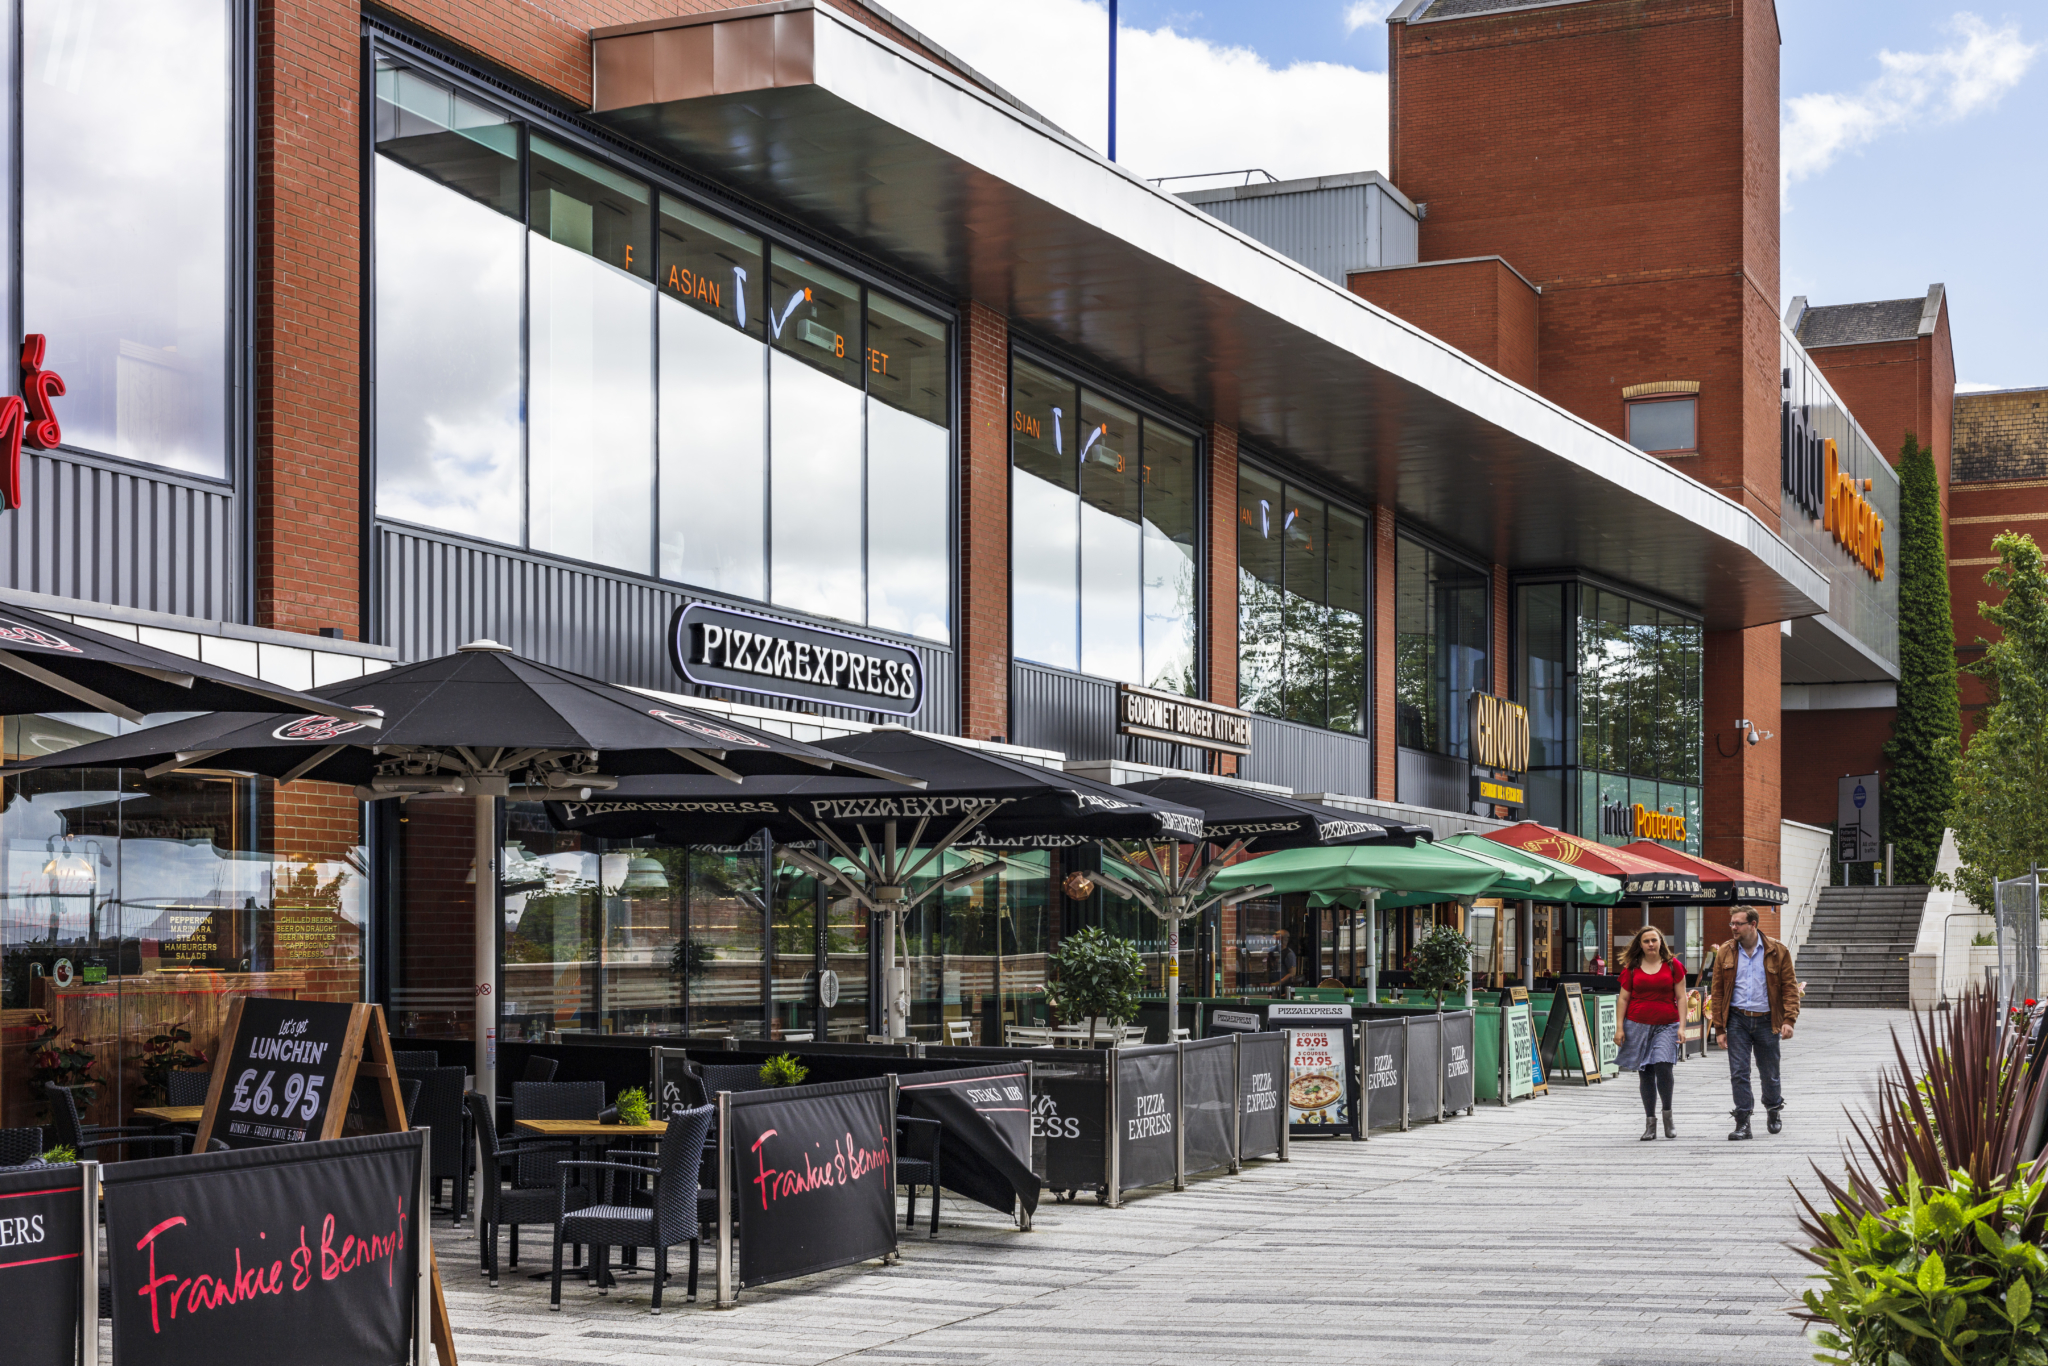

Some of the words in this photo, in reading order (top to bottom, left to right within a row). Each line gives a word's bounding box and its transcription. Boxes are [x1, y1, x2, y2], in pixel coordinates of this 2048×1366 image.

[669, 264, 720, 308] ASIAN
[1783, 367, 1825, 520] intu
[1825, 437, 1885, 582] Potteries
[702, 622, 915, 700] PIZZAEXPRESS
[1127, 694, 1176, 731] GOURMET
[1177, 705, 1213, 738] BURGER
[1214, 715, 1251, 745] KITCHEN
[1477, 692, 1530, 774] CHIQUITO
[562, 801, 780, 821] PIZZAEXPRESS
[1601, 793, 1634, 838] intu
[1634, 802, 1687, 842] Potteries
[169, 916, 213, 924] PEPPERONI
[170, 925, 212, 933] MARINARA
[276, 925, 294, 933] BEER
[294, 925, 305, 933] ON
[305, 925, 338, 933] DRAUGHT
[281, 916, 309, 924] CHILLED
[309, 916, 333, 924] BEERS
[164, 943, 217, 951] HAMBURGERS
[176, 934, 207, 942] STEAKS
[278, 933, 296, 941] BEER
[297, 933, 304, 941] IN
[304, 933, 336, 941] BOTTLES
[285, 942, 329, 950] CAPPUCCINO
[176, 952, 207, 960] SALADS
[289, 950, 325, 958] ESPRESSO
[1278, 1007, 1343, 1015] PIZZAEXPRESS
[278, 1018, 296, 1036] Let's
[294, 1018, 310, 1037] get
[249, 1036, 328, 1064] LUNCHIN'
[1296, 1037, 1329, 1047] £9.95
[1374, 1054, 1393, 1072] PIZZA
[1451, 1045, 1465, 1062] PIZZA
[1447, 1058, 1469, 1078] EXPRESS
[1252, 1072, 1273, 1093] PIZZA
[1368, 1069, 1398, 1090] EXPRESS
[229, 1068, 325, 1121] £6.95
[966, 1087, 1003, 1103] STEAKS
[1246, 1090, 1277, 1114] EXPRESS
[1136, 1093, 1165, 1117] PIZZA
[1128, 1112, 1171, 1140] EXPRESS
[751, 1128, 835, 1211] Frankie
[845, 1124, 890, 1190] Benny's
[0, 1214, 45, 1247] ERS
[136, 1215, 284, 1334] Frankie
[320, 1195, 407, 1288] Benny's
